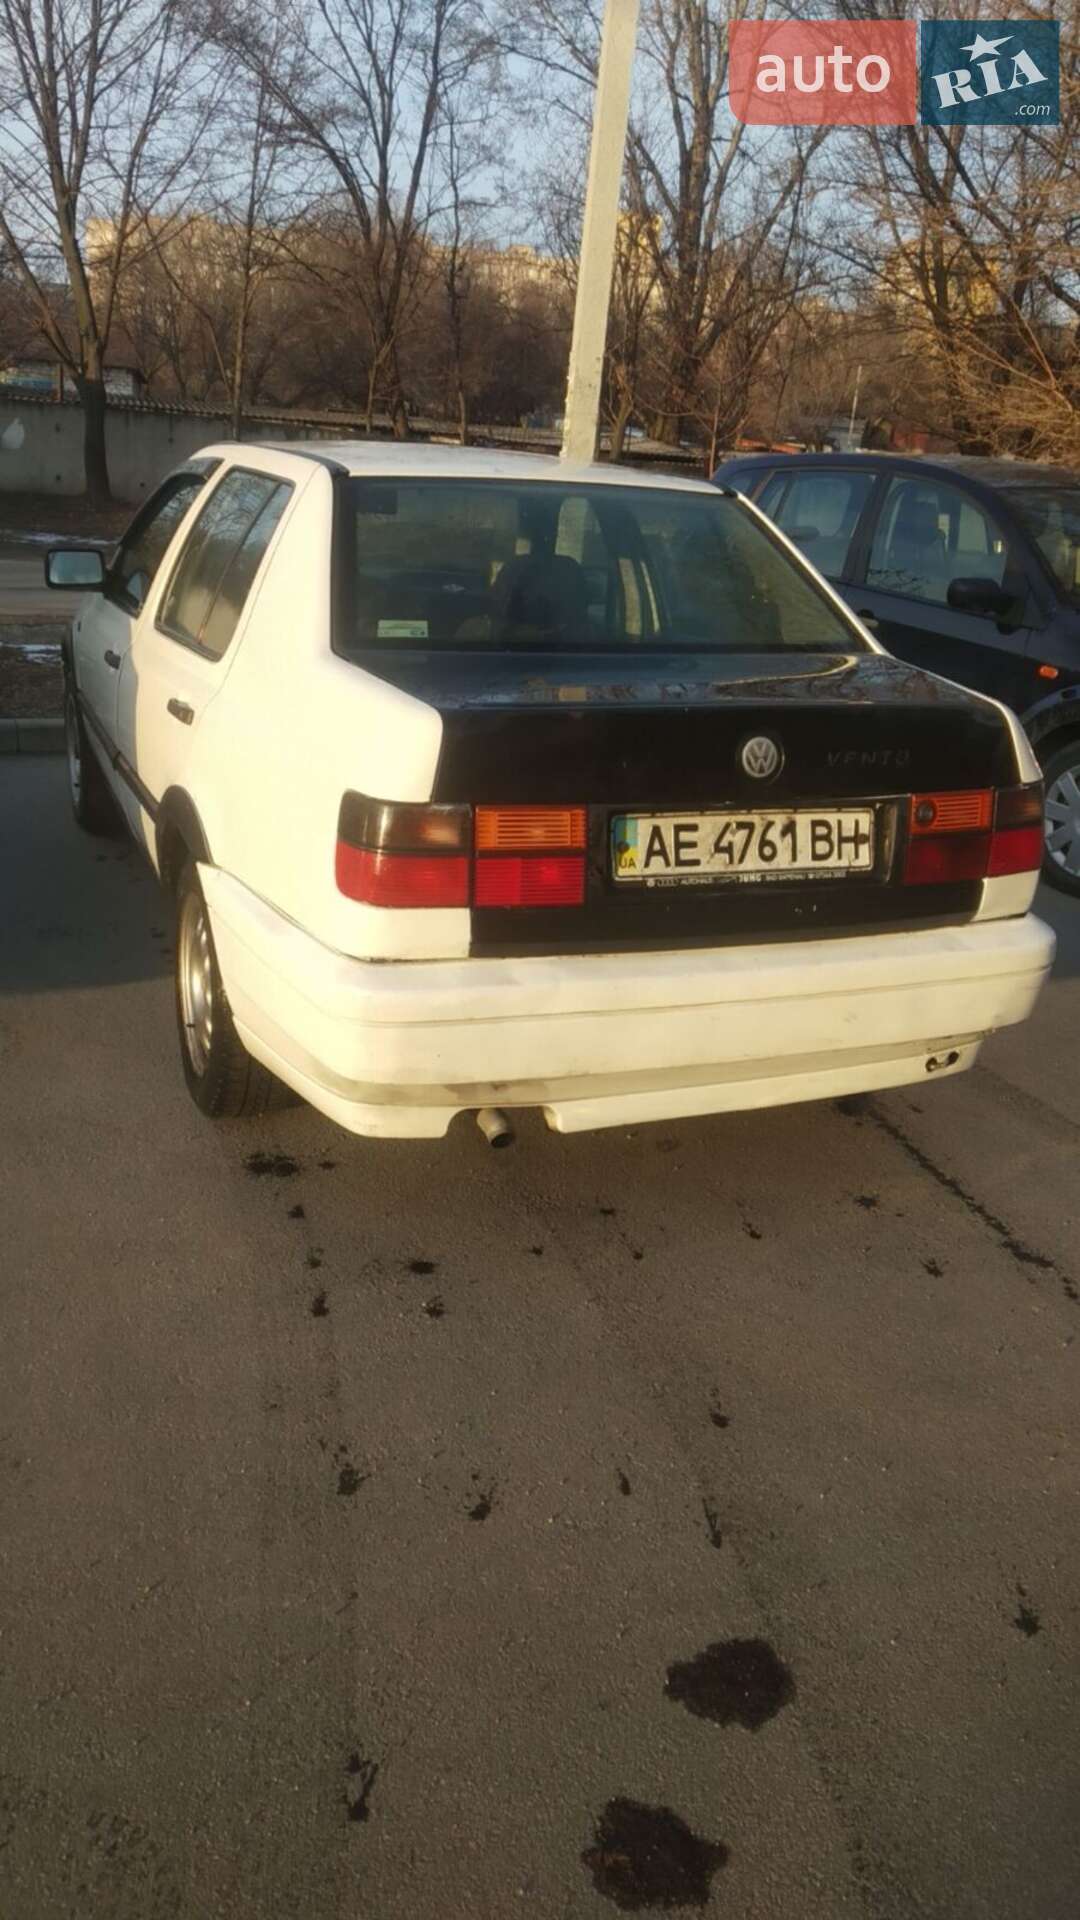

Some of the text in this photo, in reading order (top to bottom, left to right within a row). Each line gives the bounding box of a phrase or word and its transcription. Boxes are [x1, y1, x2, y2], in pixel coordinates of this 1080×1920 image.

[643, 818, 860, 868] AE 4761 BH
[618, 856, 637, 869] UA
